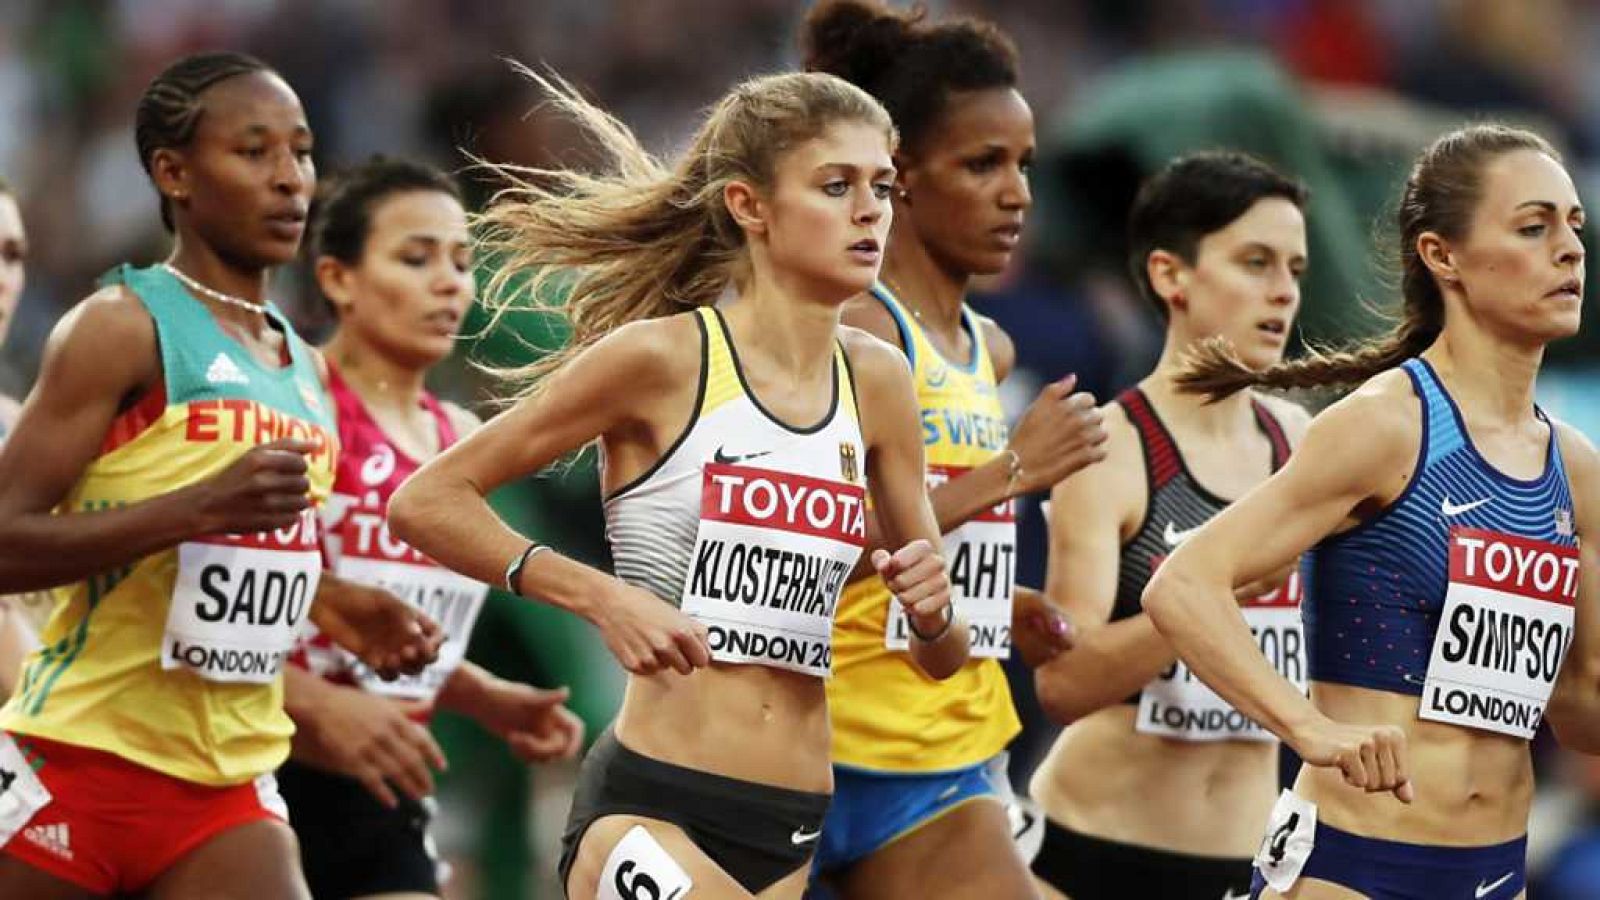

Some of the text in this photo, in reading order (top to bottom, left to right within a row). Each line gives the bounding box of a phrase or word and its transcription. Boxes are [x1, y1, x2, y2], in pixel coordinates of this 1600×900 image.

[712, 474, 865, 538] TOYOTA
[195, 563, 307, 626] SADO
[690, 539, 849, 617] KLOSTERHA
[951, 541, 1013, 599] AHT
[1457, 537, 1579, 597] TOYOT
[171, 641, 267, 673] LONDON
[707, 625, 807, 665] ONDON
[1432, 686, 1531, 729] LONDON
